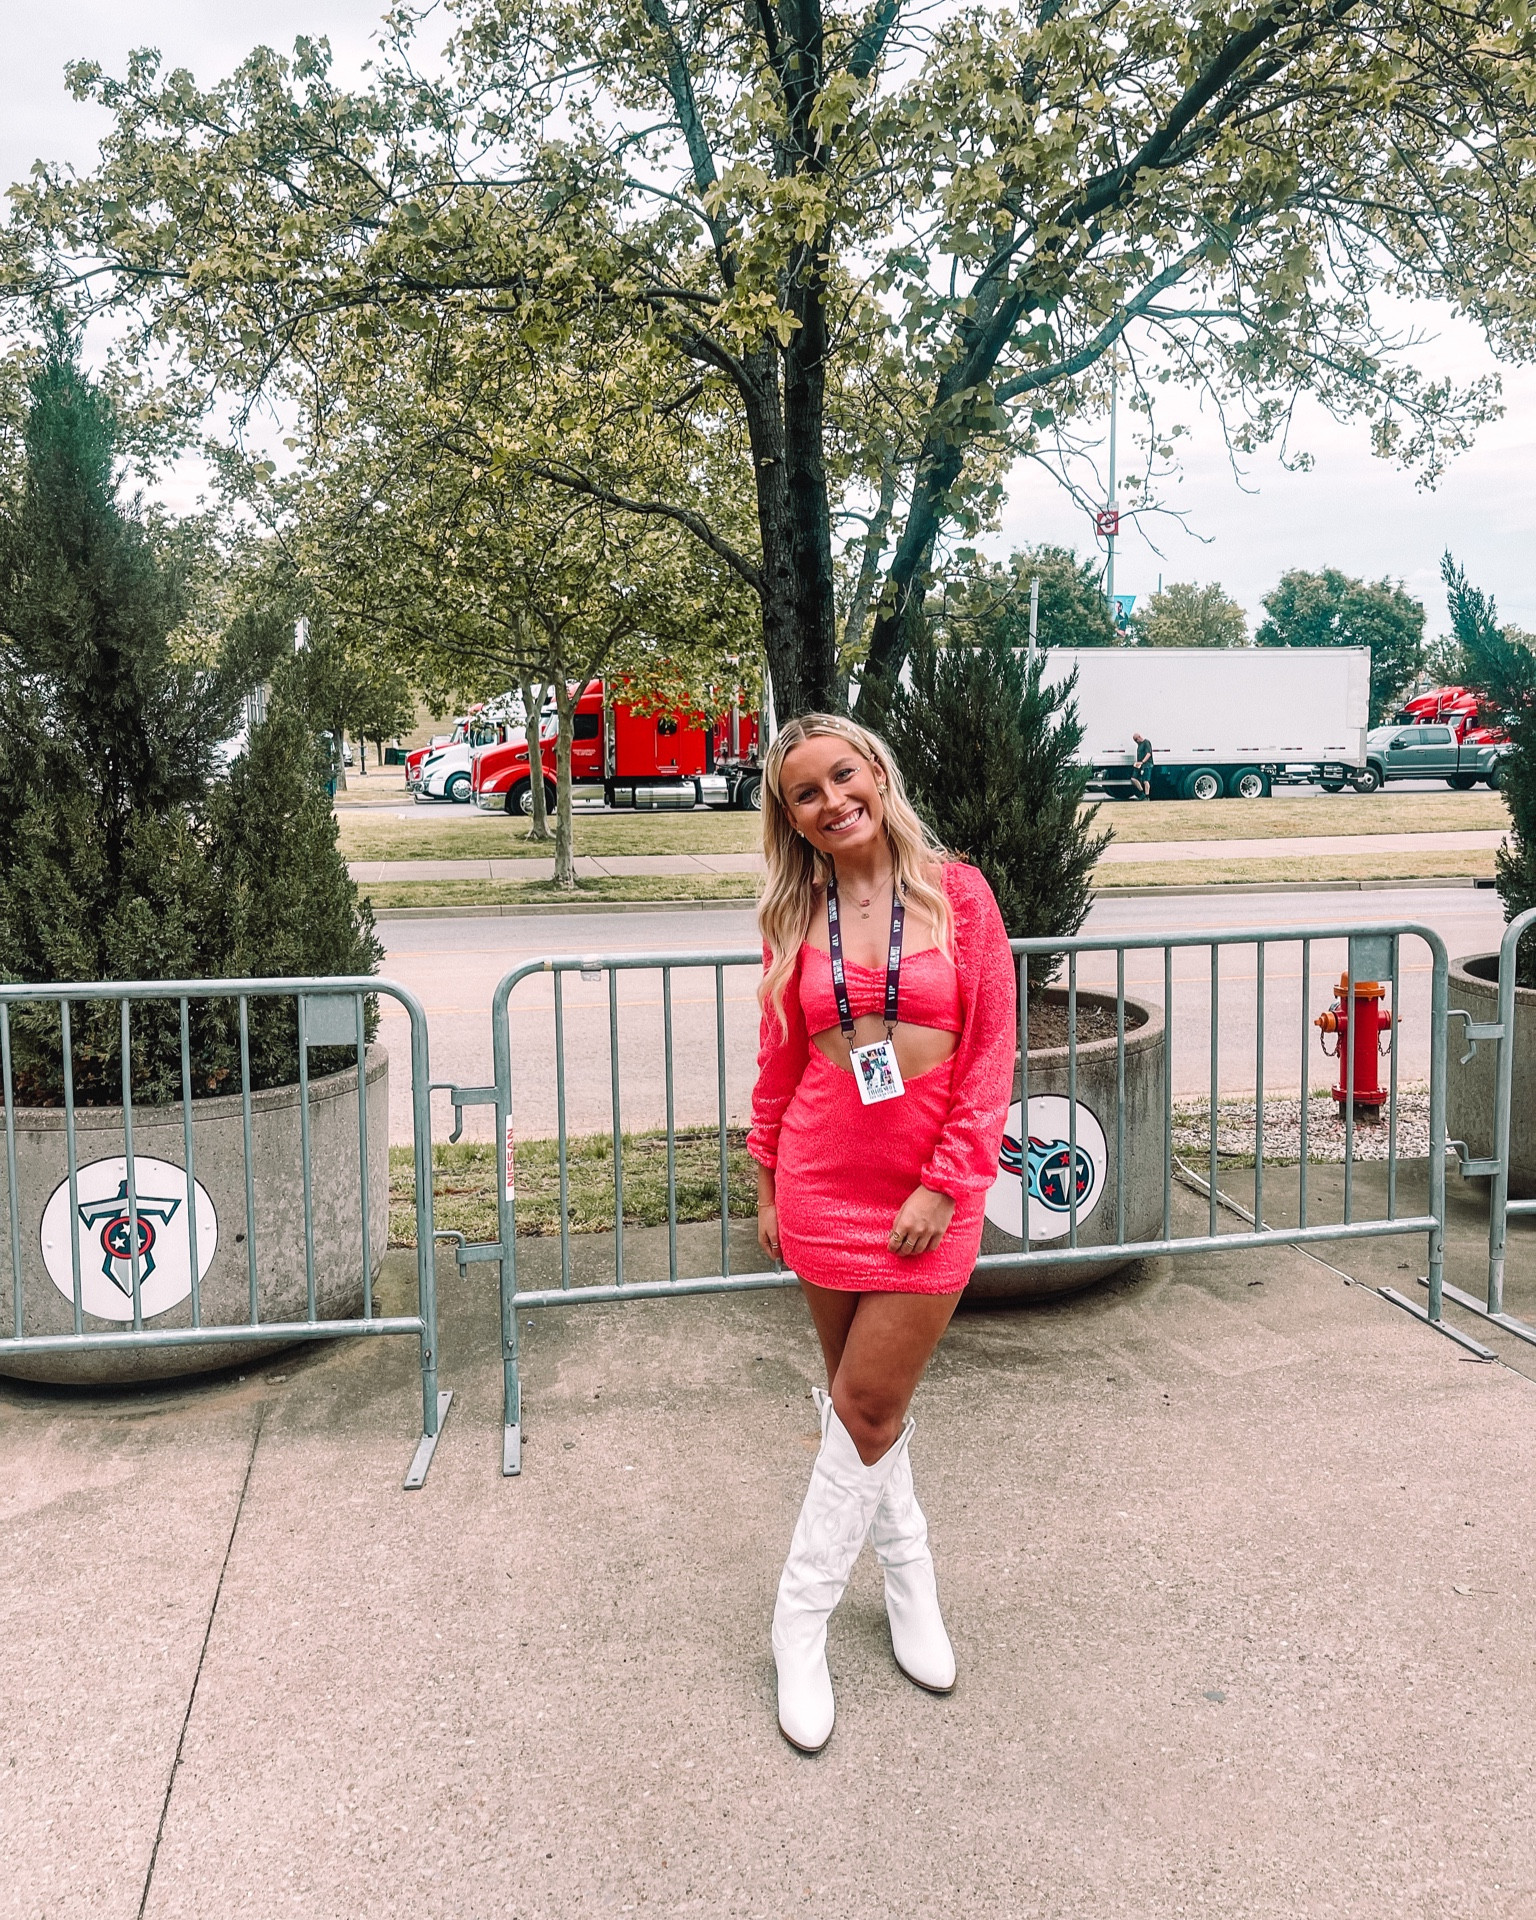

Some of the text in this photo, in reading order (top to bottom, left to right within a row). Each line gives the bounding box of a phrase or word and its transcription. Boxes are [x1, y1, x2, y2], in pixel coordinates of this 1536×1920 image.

[1100, 513, 1116, 534] G
[893, 919, 901, 933] VIP
[831, 933, 839, 947] VIP
[888, 985, 896, 1001] VIP
[839, 998, 848, 1014] VIP
